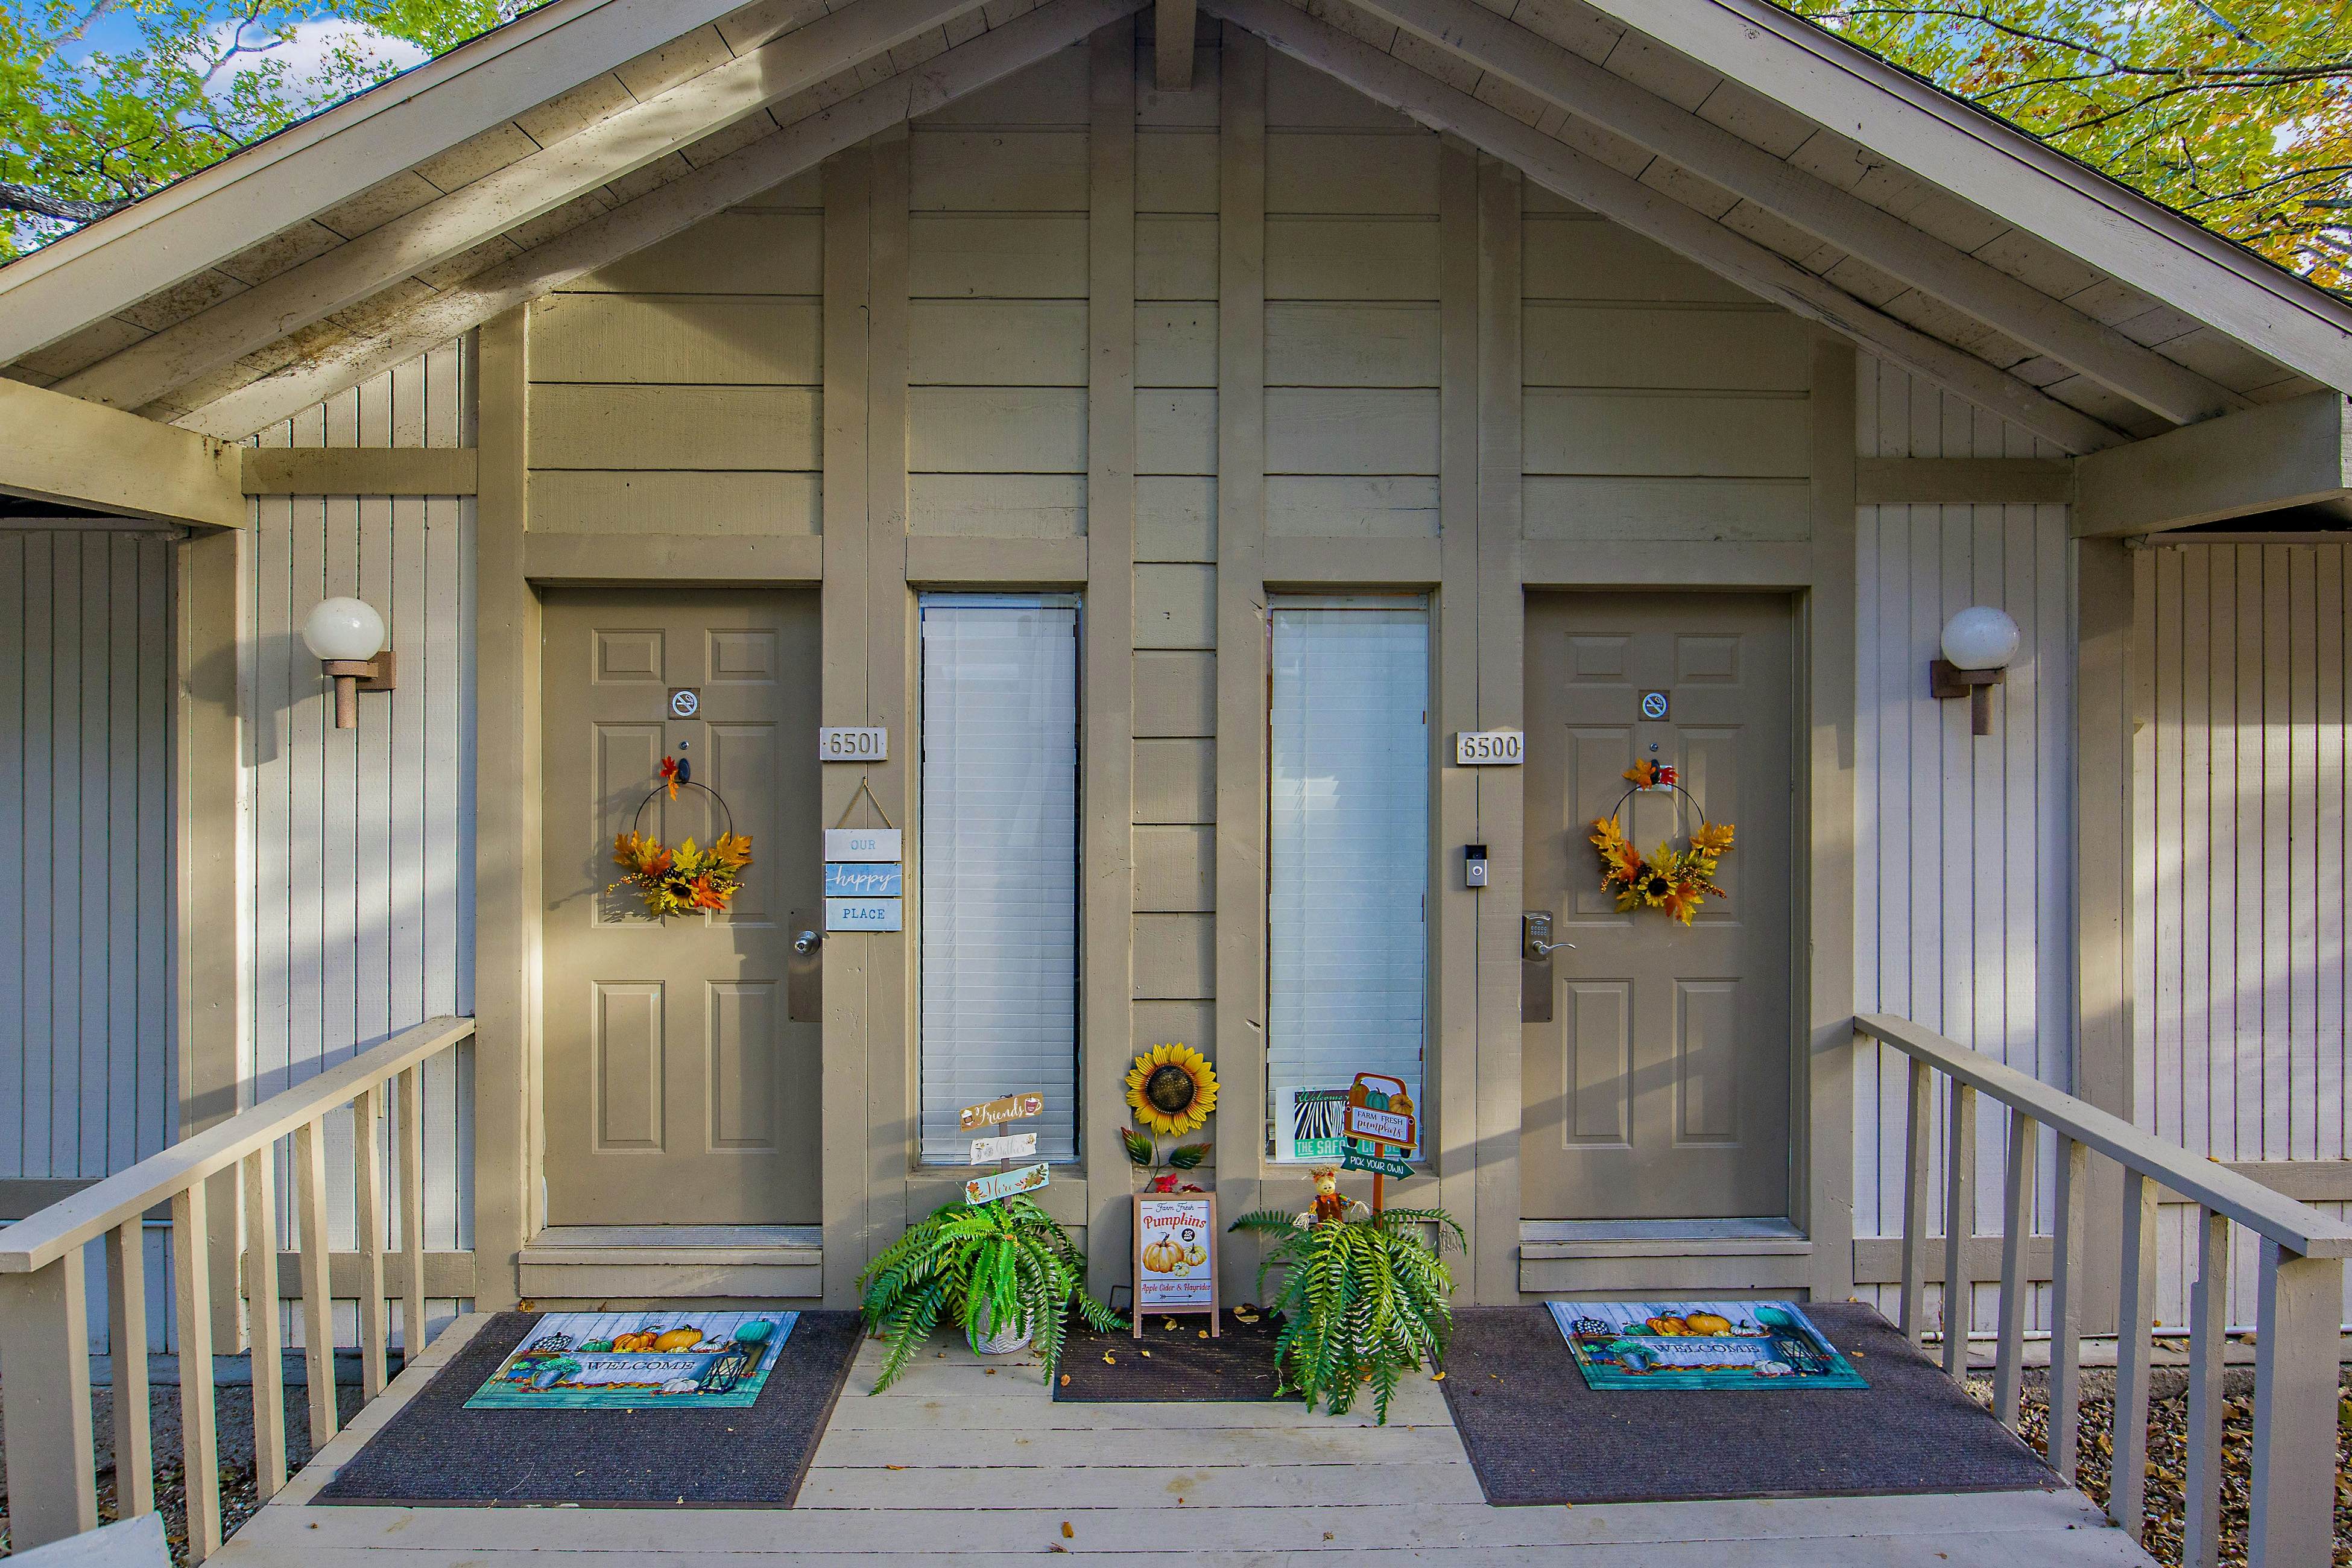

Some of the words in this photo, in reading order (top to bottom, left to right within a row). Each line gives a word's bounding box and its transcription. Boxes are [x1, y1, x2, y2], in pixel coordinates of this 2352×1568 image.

[830, 733, 879, 754] 6501
[1464, 737, 1518, 758] 6500
[850, 839, 876, 850] OUR
[826, 865, 902, 891] happy
[842, 908, 885, 920] PLACE
[1297, 1086, 1343, 1102] Welcome
[975, 1097, 1025, 1126] Friends
[1358, 1111, 1377, 1120] FARM
[1381, 1113, 1403, 1125] FRESH
[1357, 1119, 1403, 1138] pumpkins
[1297, 1141, 1314, 1153] THE
[1317, 1139, 1346, 1154] SAFA
[1350, 1155, 1365, 1166] PICK
[1367, 1158, 1385, 1171] YOUR
[1387, 1163, 1404, 1175] OWN
[1155, 1202, 1175, 1212] Farm
[1176, 1202, 1195, 1212] Fresh
[1143, 1212, 1207, 1230] Pumpkins
[1142, 1283, 1157, 1294] Apple
[1184, 1283, 1211, 1294] Hayrides
[587, 1361, 695, 1370] WELCOME
